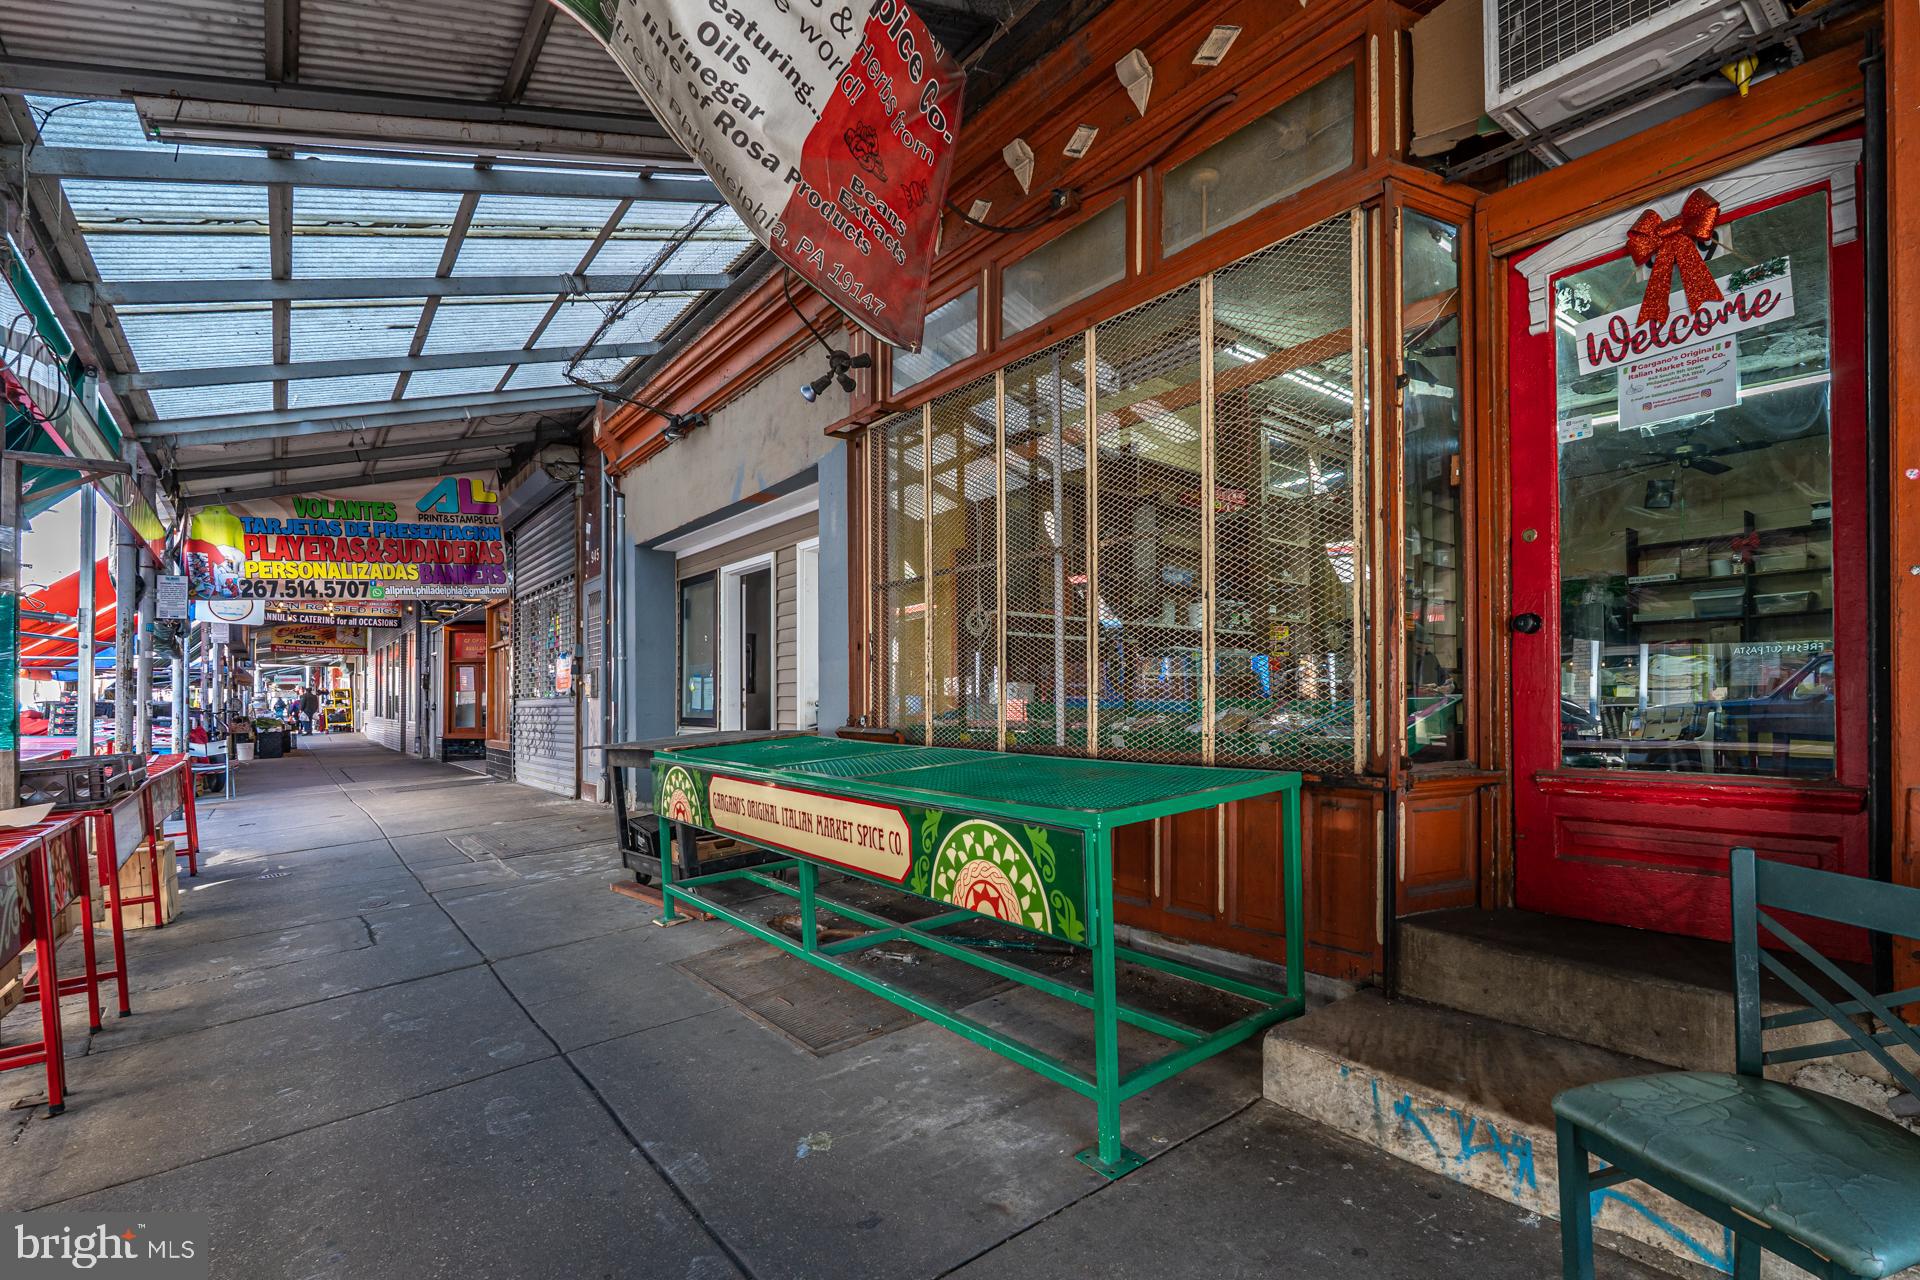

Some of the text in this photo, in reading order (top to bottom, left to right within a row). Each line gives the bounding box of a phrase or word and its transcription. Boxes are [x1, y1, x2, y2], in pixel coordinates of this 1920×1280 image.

[668, 18, 765, 120] Vinegar
[697, 21, 750, 75] Oils
[800, 16, 865, 105] world!
[830, 6, 935, 166] & Herbs from
[920, 79, 952, 144] Co.
[642, 11, 872, 256] line of Rosa Products
[669, 97, 789, 247] Philadelphia,
[794, 235, 825, 271] PA
[827, 263, 886, 317] 19147
[838, 186, 907, 266] Extracts
[850, 174, 906, 236] Beans
[1586, 288, 1782, 367] Welcome
[1628, 351, 1726, 380] Italian Market Spice Co.
[1638, 345, 1714, 370] Gargano's Original
[240, 517, 501, 541] TARJETAS DE PRESENTACION
[293, 495, 397, 522] VOLANTES
[484, 516, 499, 524] LLC
[240, 579, 369, 599] 267.514.5707
[244, 560, 507, 585] PERSONALIZADAS BANNERS
[385, 585, 508, 597] allprint.philadelphia@gmail.com
[300, 613, 335, 625] CATERING
[337, 616, 347, 625] for
[349, 617, 357, 625] all
[358, 618, 398, 627] OCCASIONS
[305, 603, 366, 614] ROSTED
[371, 606, 399, 615] PIGS
[712, 792, 904, 856] GARGANO'S ORIGINAL ITALIAN MARKET SPICE CO.
